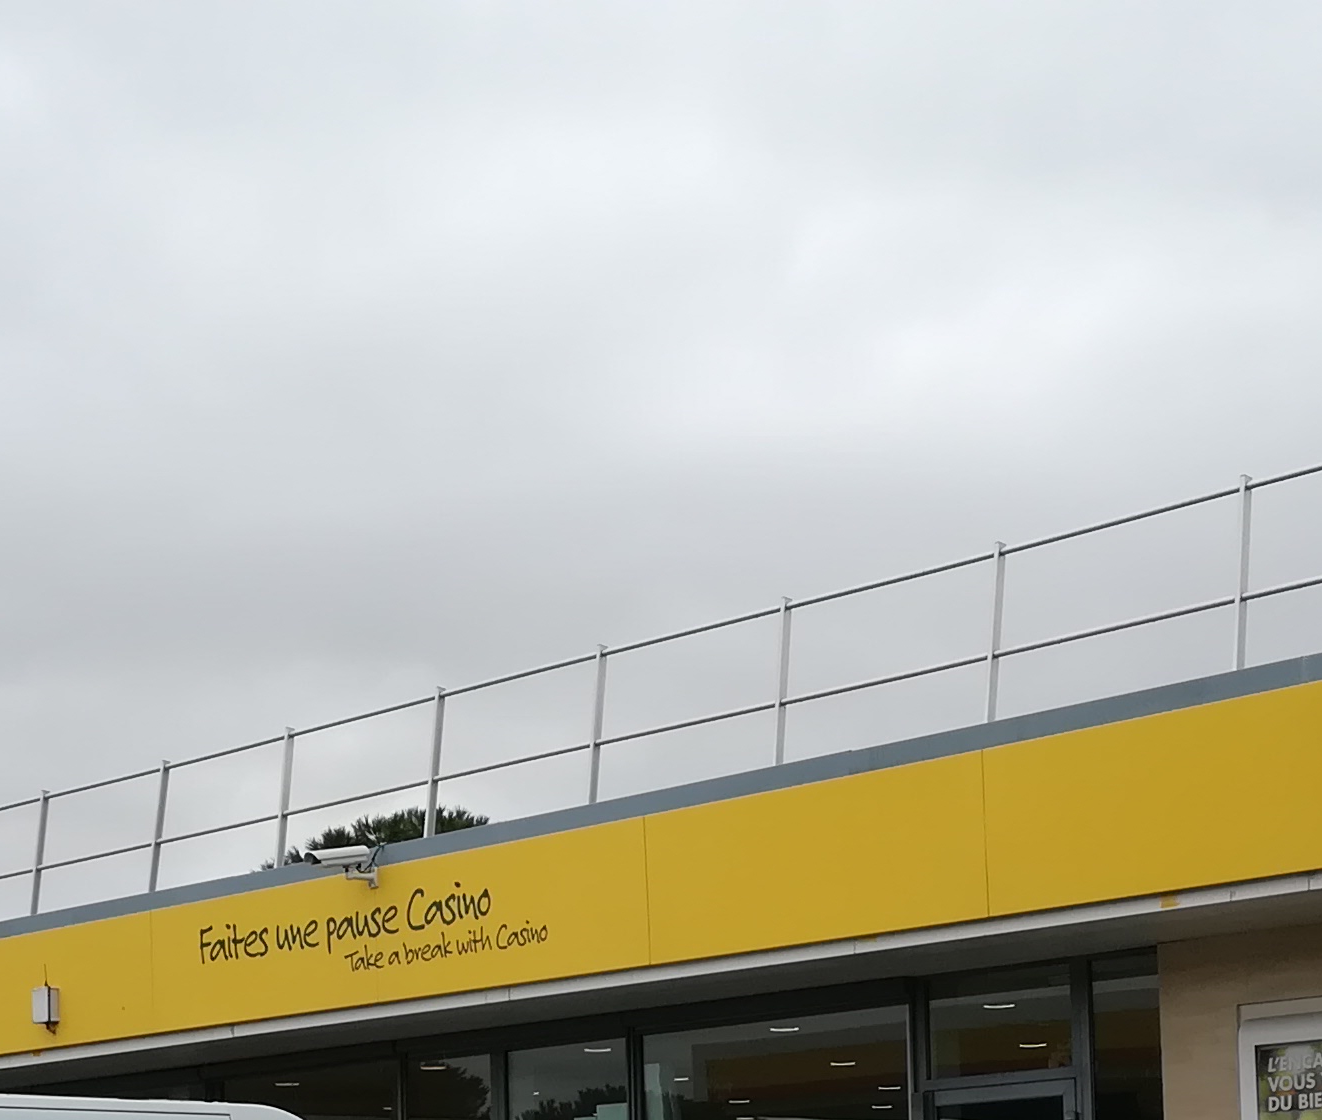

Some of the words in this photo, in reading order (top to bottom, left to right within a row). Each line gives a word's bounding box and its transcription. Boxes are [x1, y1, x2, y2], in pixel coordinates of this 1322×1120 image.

[199, 923, 269, 964] Faites
[276, 919, 319, 951] une
[326, 905, 399, 954] pause
[406, 881, 491, 931] Casino
[344, 944, 384, 972] Take
[388, 950, 401, 966] a
[403, 931, 452, 965] break
[456, 926, 492, 955] with
[496, 920, 548, 949] Casino
[1267, 1072, 1316, 1092] VOUS
[1268, 1094, 1292, 1111] DU
